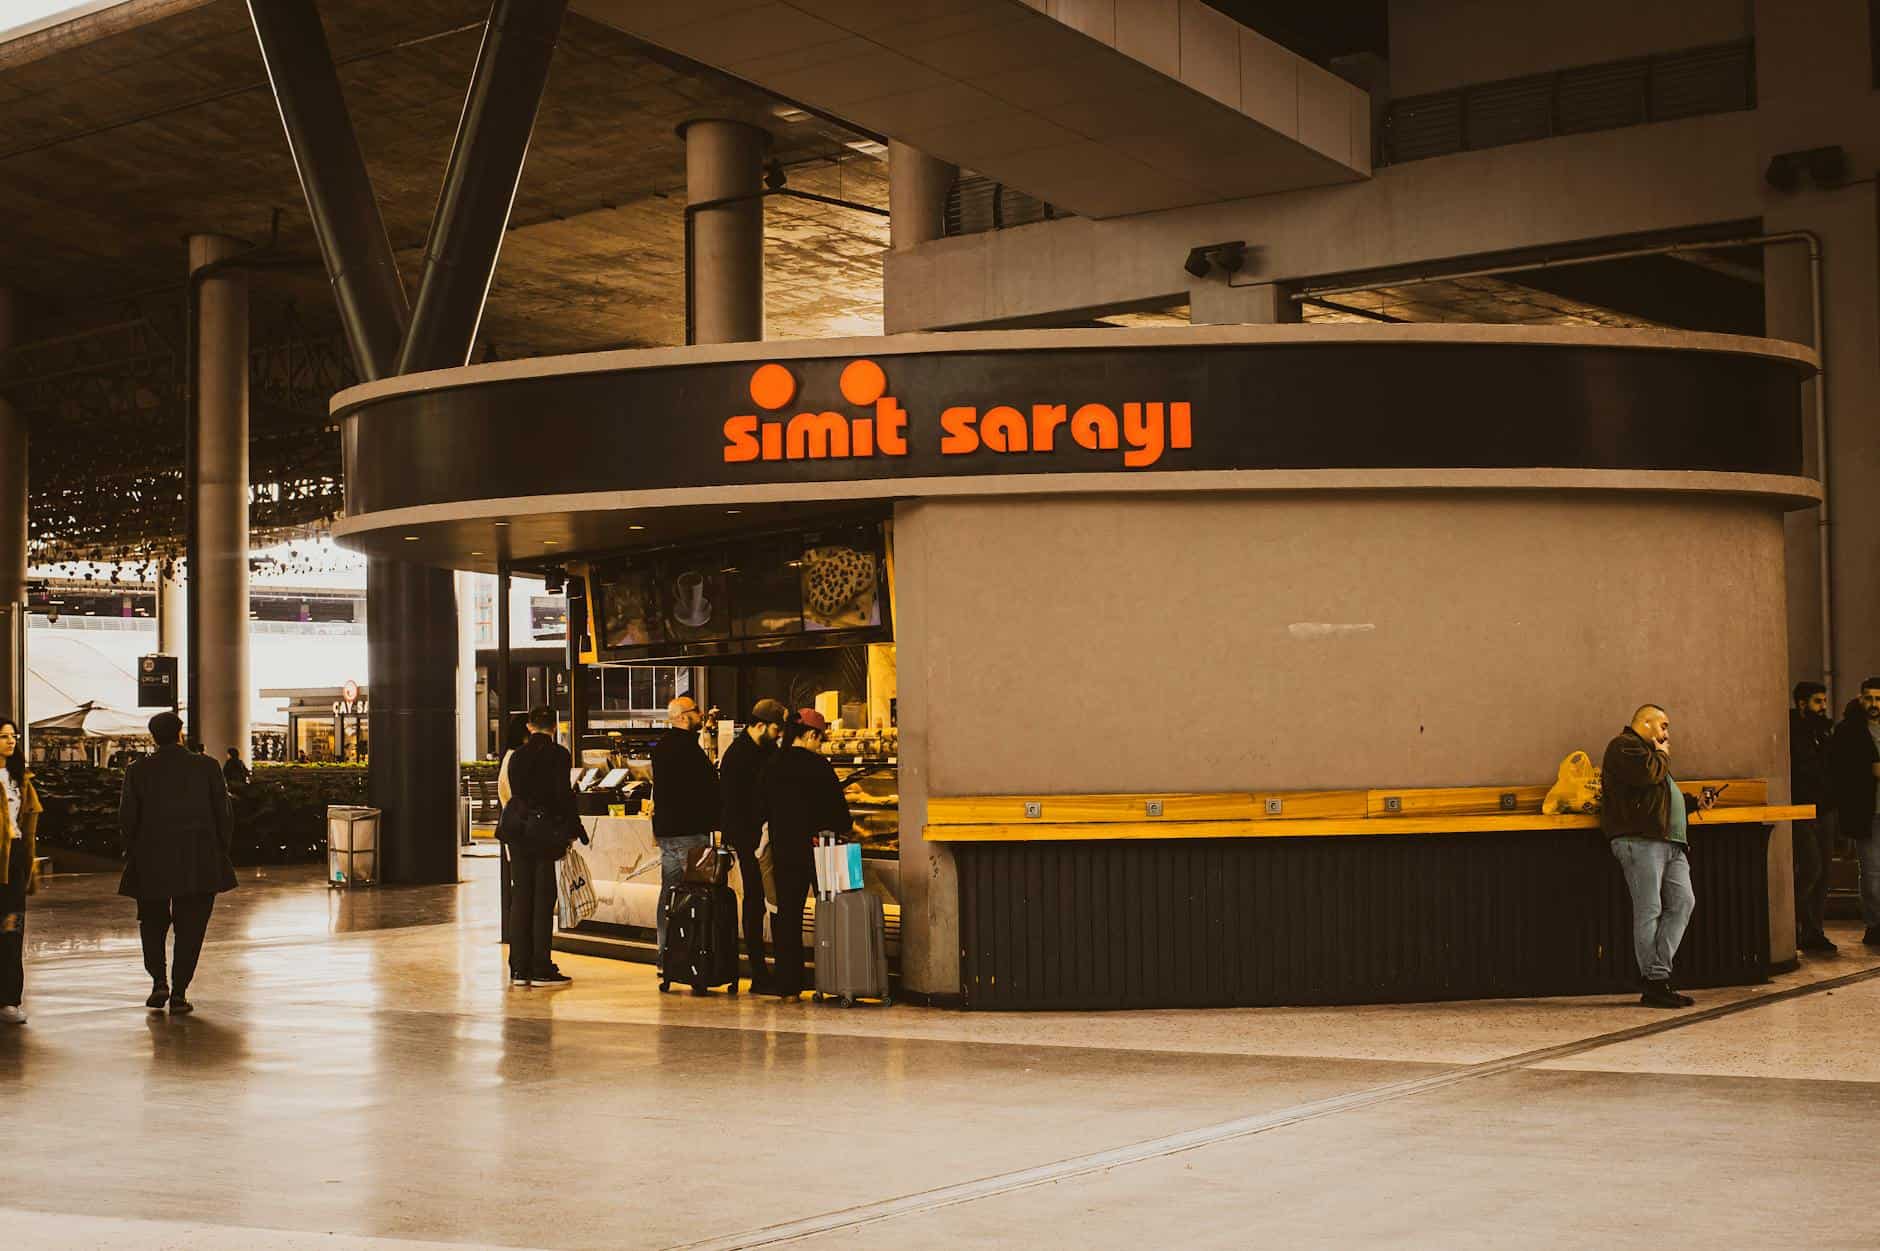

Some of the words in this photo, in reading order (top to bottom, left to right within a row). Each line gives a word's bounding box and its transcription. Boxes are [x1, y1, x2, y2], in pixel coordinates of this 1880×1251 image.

[723, 359, 907, 462] simit
[940, 402, 1192, 467] sarayı
[333, 701, 353, 718] ÇAY
